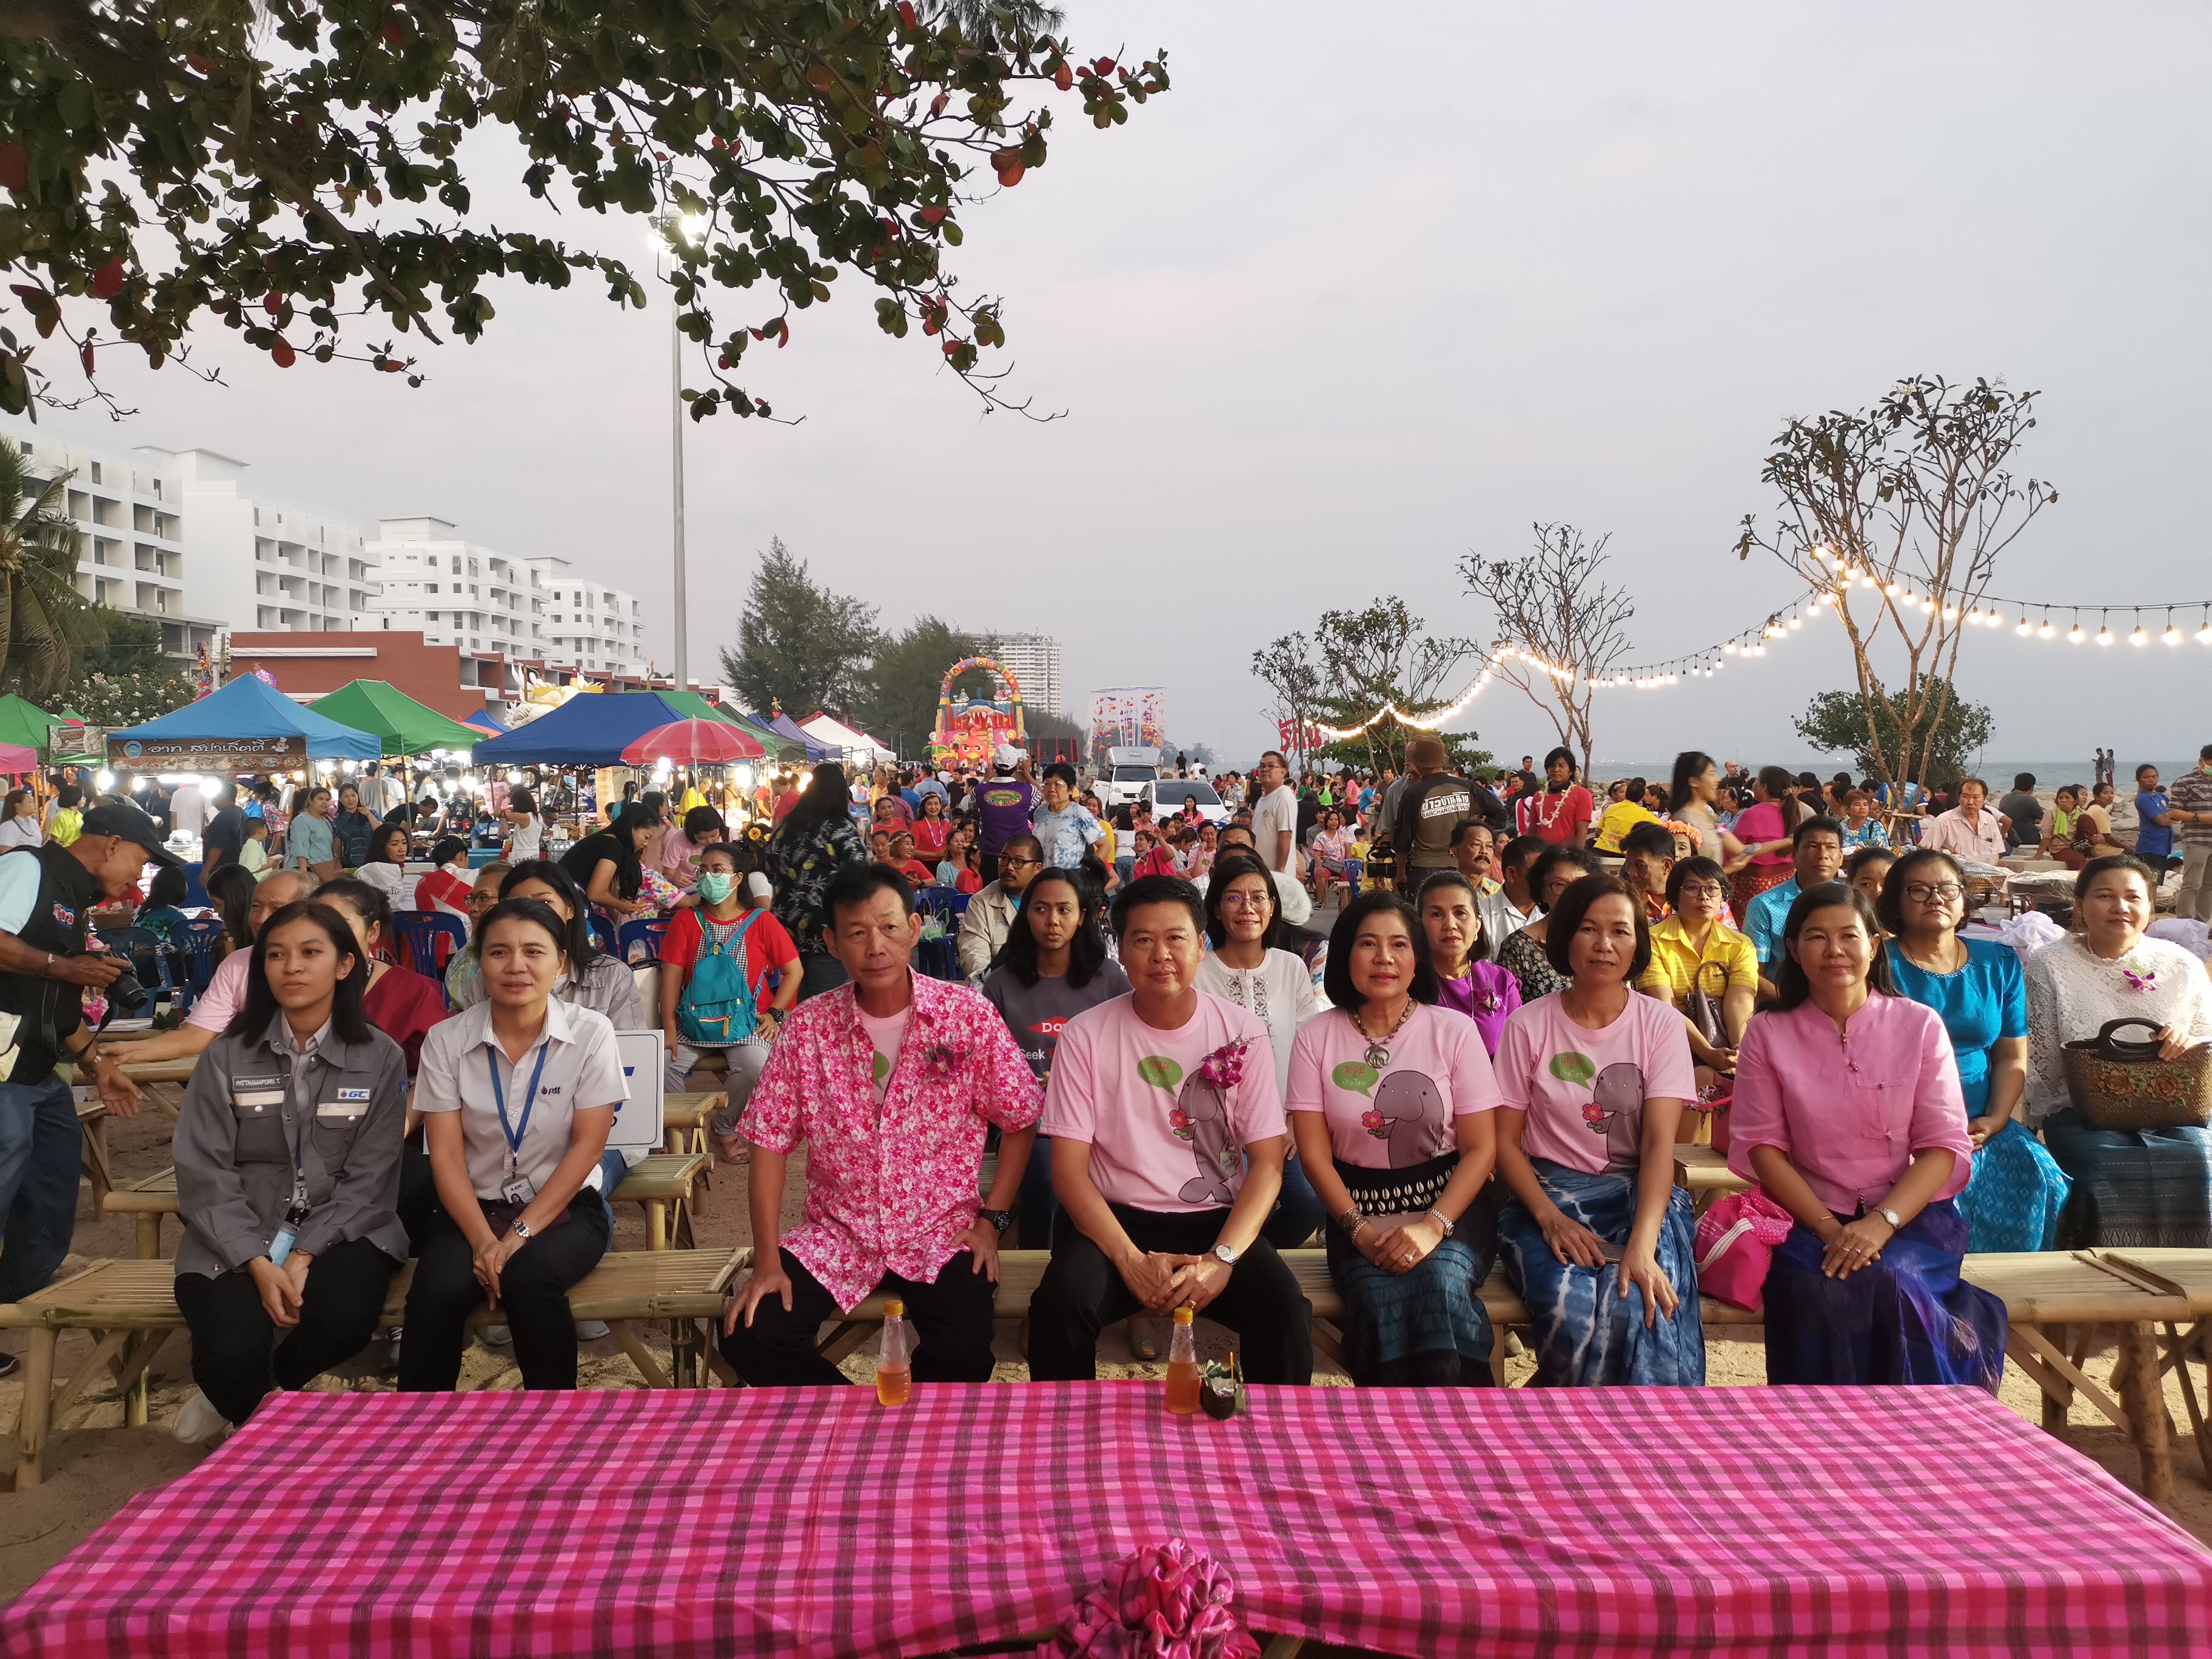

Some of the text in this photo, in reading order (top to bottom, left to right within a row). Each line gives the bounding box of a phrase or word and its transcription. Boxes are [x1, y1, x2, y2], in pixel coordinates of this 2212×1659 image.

[1421, 805, 1469, 818] BANCHANGNEWS
[1041, 1022, 1065, 1033] DO
[548, 1086, 561, 1094] ptt
